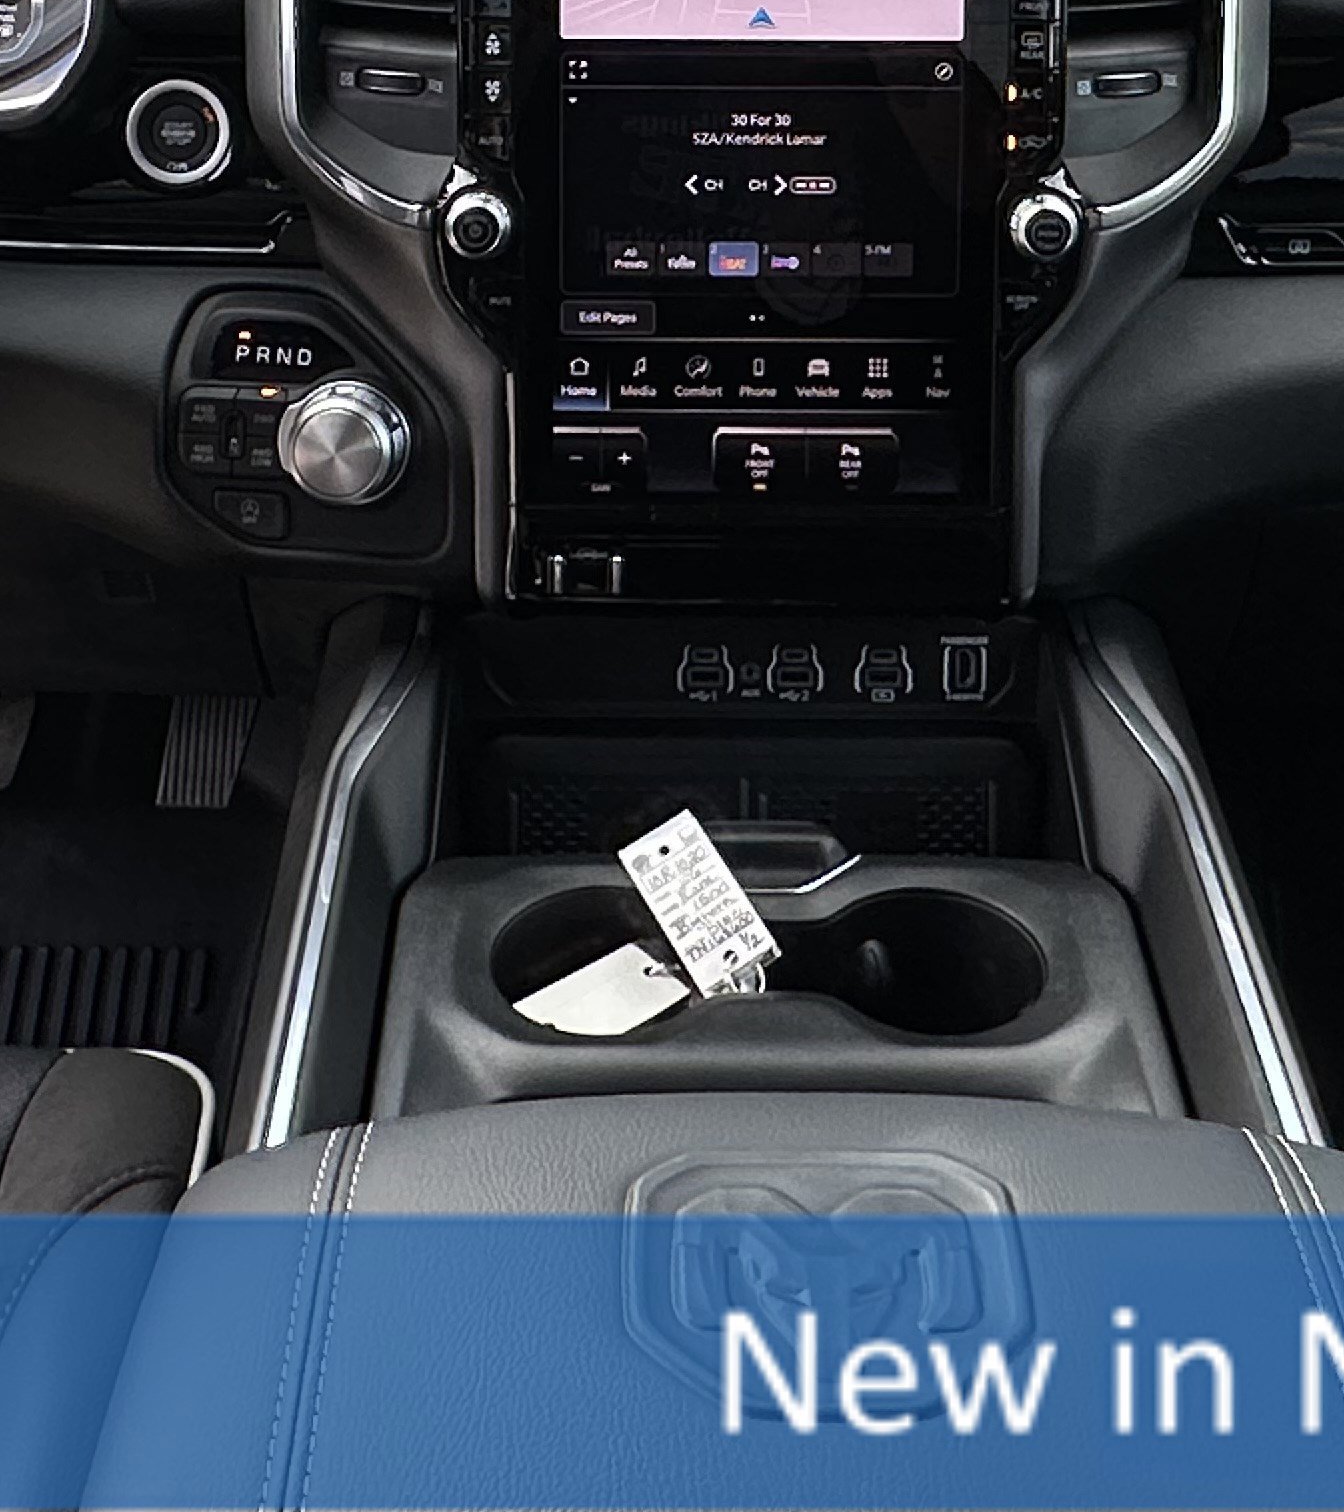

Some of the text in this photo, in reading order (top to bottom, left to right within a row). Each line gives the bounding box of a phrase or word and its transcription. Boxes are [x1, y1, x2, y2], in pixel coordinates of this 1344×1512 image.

[731, 113, 792, 127] 30 For 30
[692, 132, 828, 147] SZA/Kendrick Lamar
[578, 310, 638, 326] Edit Pages
[235, 344, 313, 366] P R N D
[560, 384, 597, 397] Home
[620, 384, 657, 397] Media
[673, 384, 724, 398] Comfort
[738, 384, 777, 398] Phone
[794, 385, 840, 398] Vehicle
[861, 386, 894, 400] Apps
[925, 386, 951, 398] Nav
